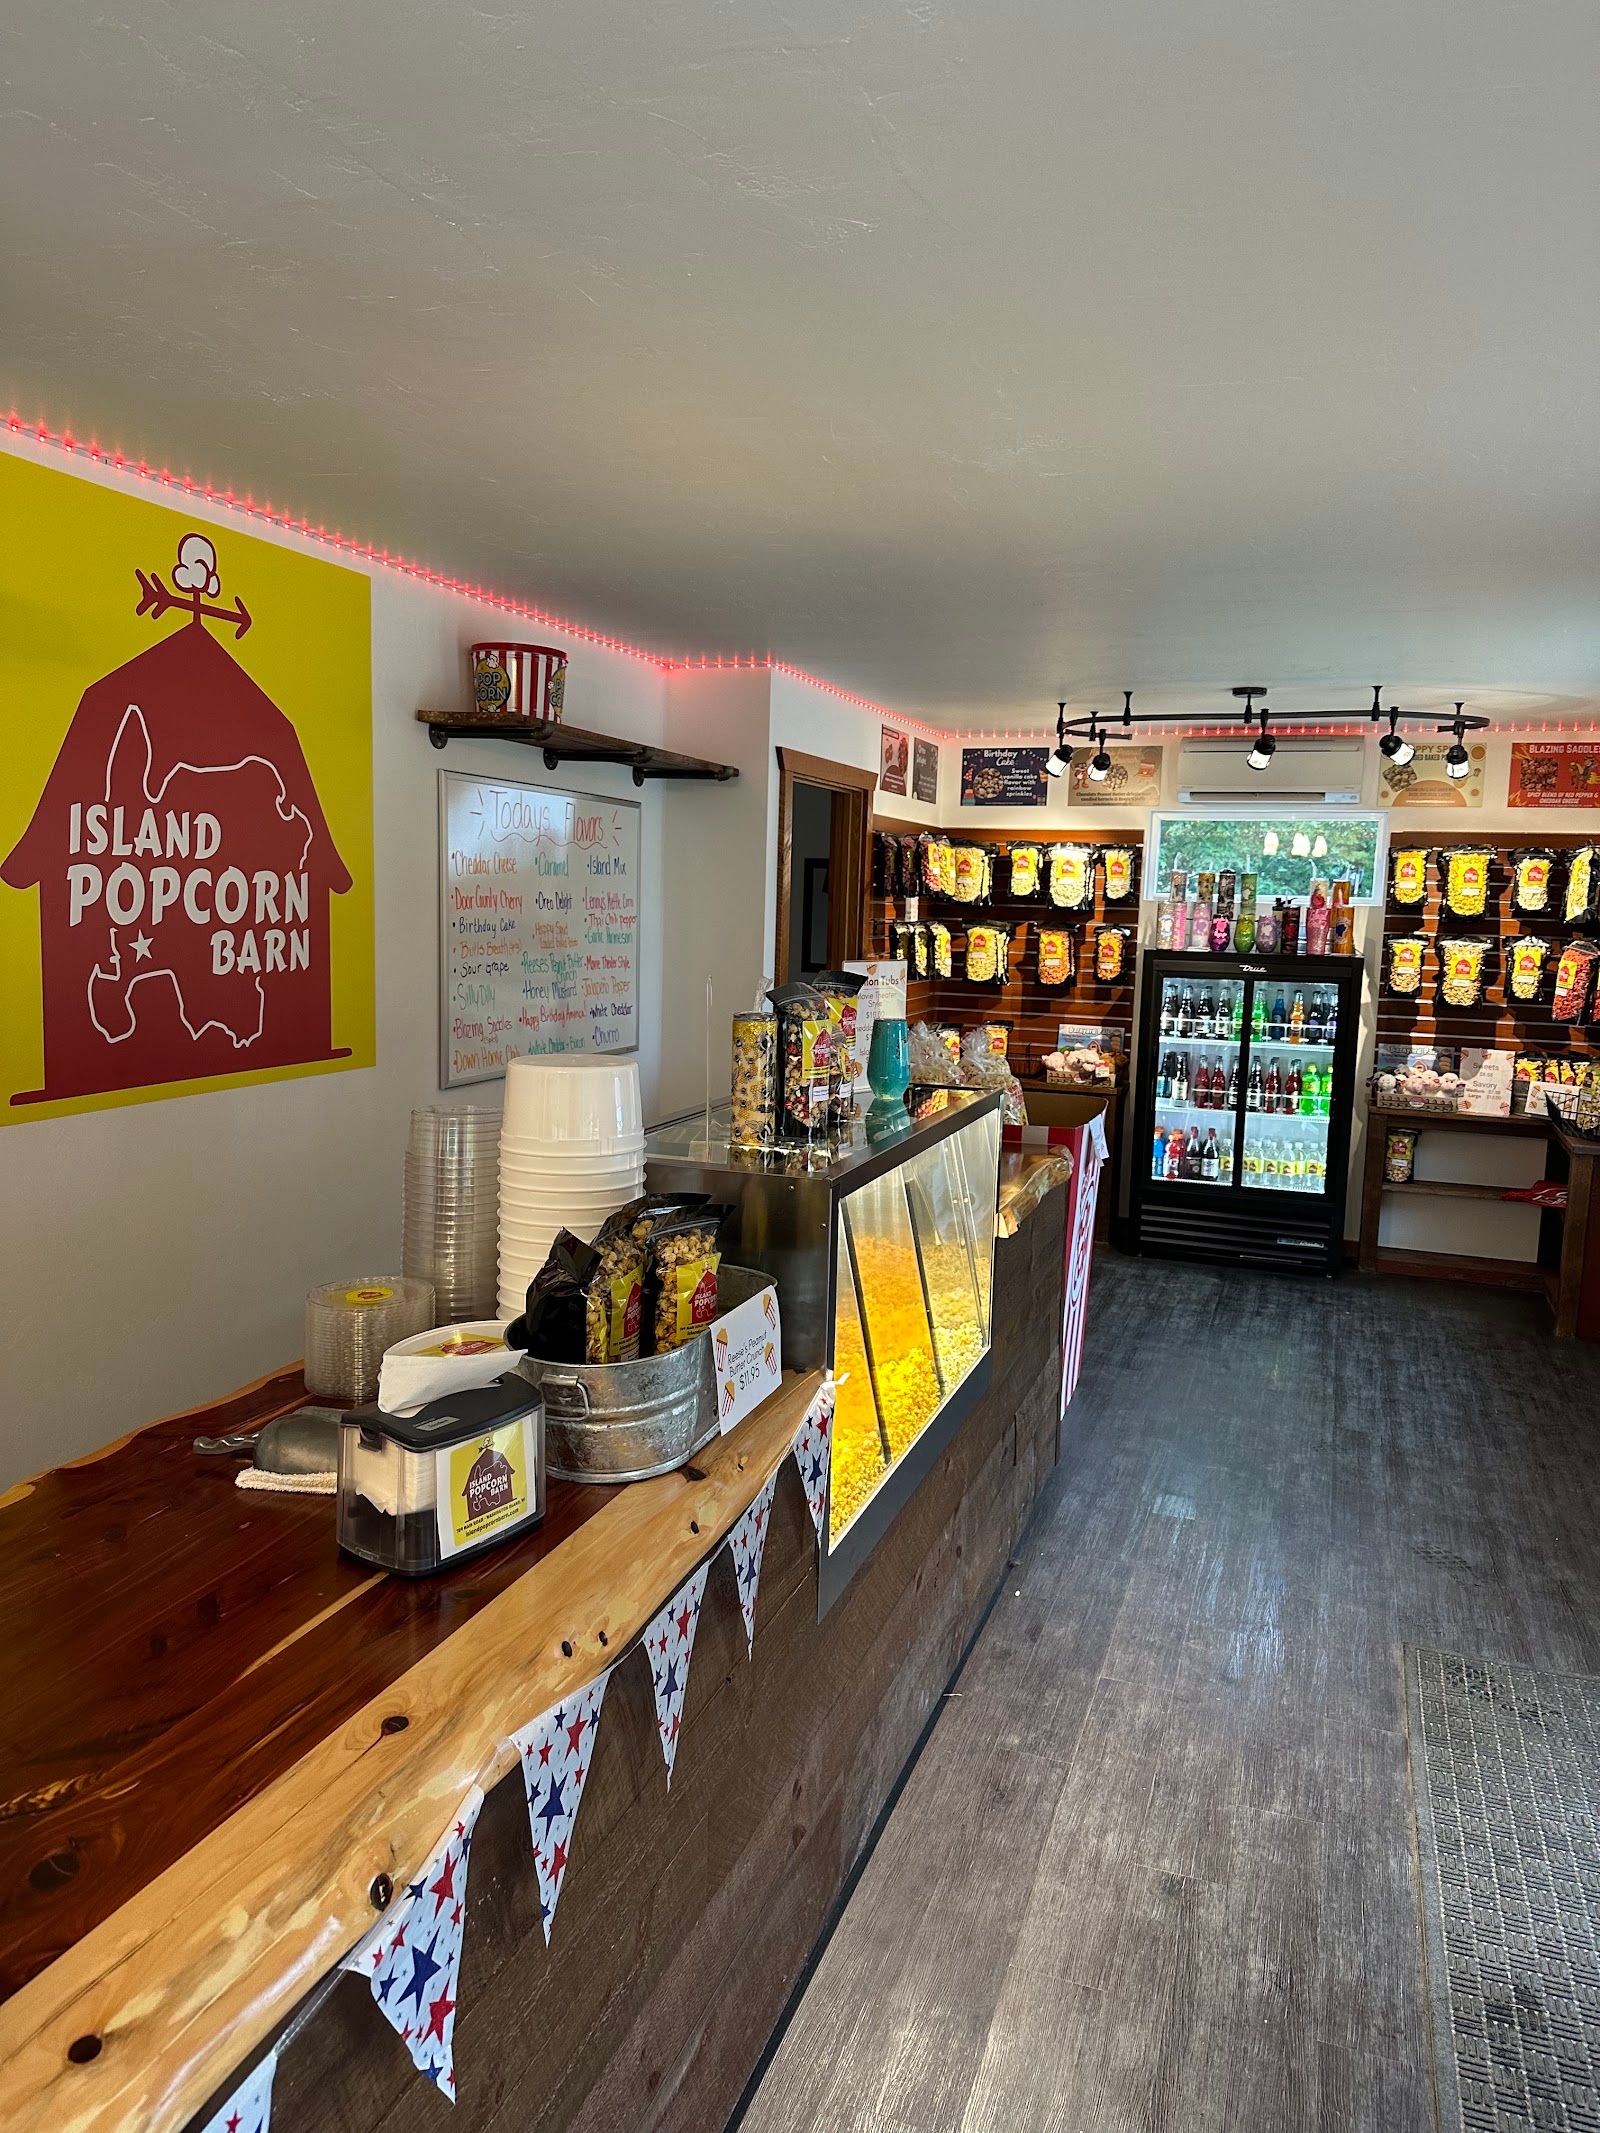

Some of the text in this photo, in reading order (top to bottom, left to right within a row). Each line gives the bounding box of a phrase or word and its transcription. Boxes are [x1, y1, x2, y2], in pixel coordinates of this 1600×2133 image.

[477, 688, 508, 701] ORN
[984, 750, 1018, 759] Birthday
[1416, 745, 1449, 753] PPY SP
[1529, 745, 1565, 754] BLAZING
[996, 757, 1015, 767] Cake
[69, 802, 222, 859] ISLAND
[565, 802, 604, 843] Flavors
[455, 850, 518, 876] Cheddar Cheese
[539, 852, 569, 878] Caramel
[590, 855, 627, 876] Island Mix
[67, 863, 310, 926] POPCORN
[455, 884, 523, 915] Door County Cherry
[538, 891, 573, 915] Oreo Delight
[459, 917, 517, 939] Birthday Cake
[211, 929, 310, 976] BARN
[461, 962, 510, 978] Sour grape
[1239, 964, 1268, 973] True
[525, 980, 578, 1003] Honey Mustard
[881, 976, 899, 986] Tubs
[457, 983, 479, 1011] Silly
[876, 991, 897, 999] Theater
[522, 1006, 540, 1032] Happy
[592, 1003, 633, 1019] White Cheddar
[487, 1016, 513, 1035] Saddles
[594, 1025, 620, 1047] Churro
[455, 1050, 480, 1074] Down
[480, 1047, 504, 1069] Home
[1473, 1063, 1500, 1071] Sweets
[1473, 1081, 1498, 1090] Savory
[727, 1330, 767, 1365] Reese's Peanut
[730, 1361, 746, 1378] Butter
[740, 1362, 761, 1391] $11.95
[469, 1473, 492, 1489] ISLAND
[469, 1473, 508, 1499] POPCORN
[491, 1483, 509, 1496] BARN
[464, 1523, 473, 1531] MAIN
[474, 1518, 484, 1527] ROAD
[487, 1505, 509, 1519] WASHINGTON
